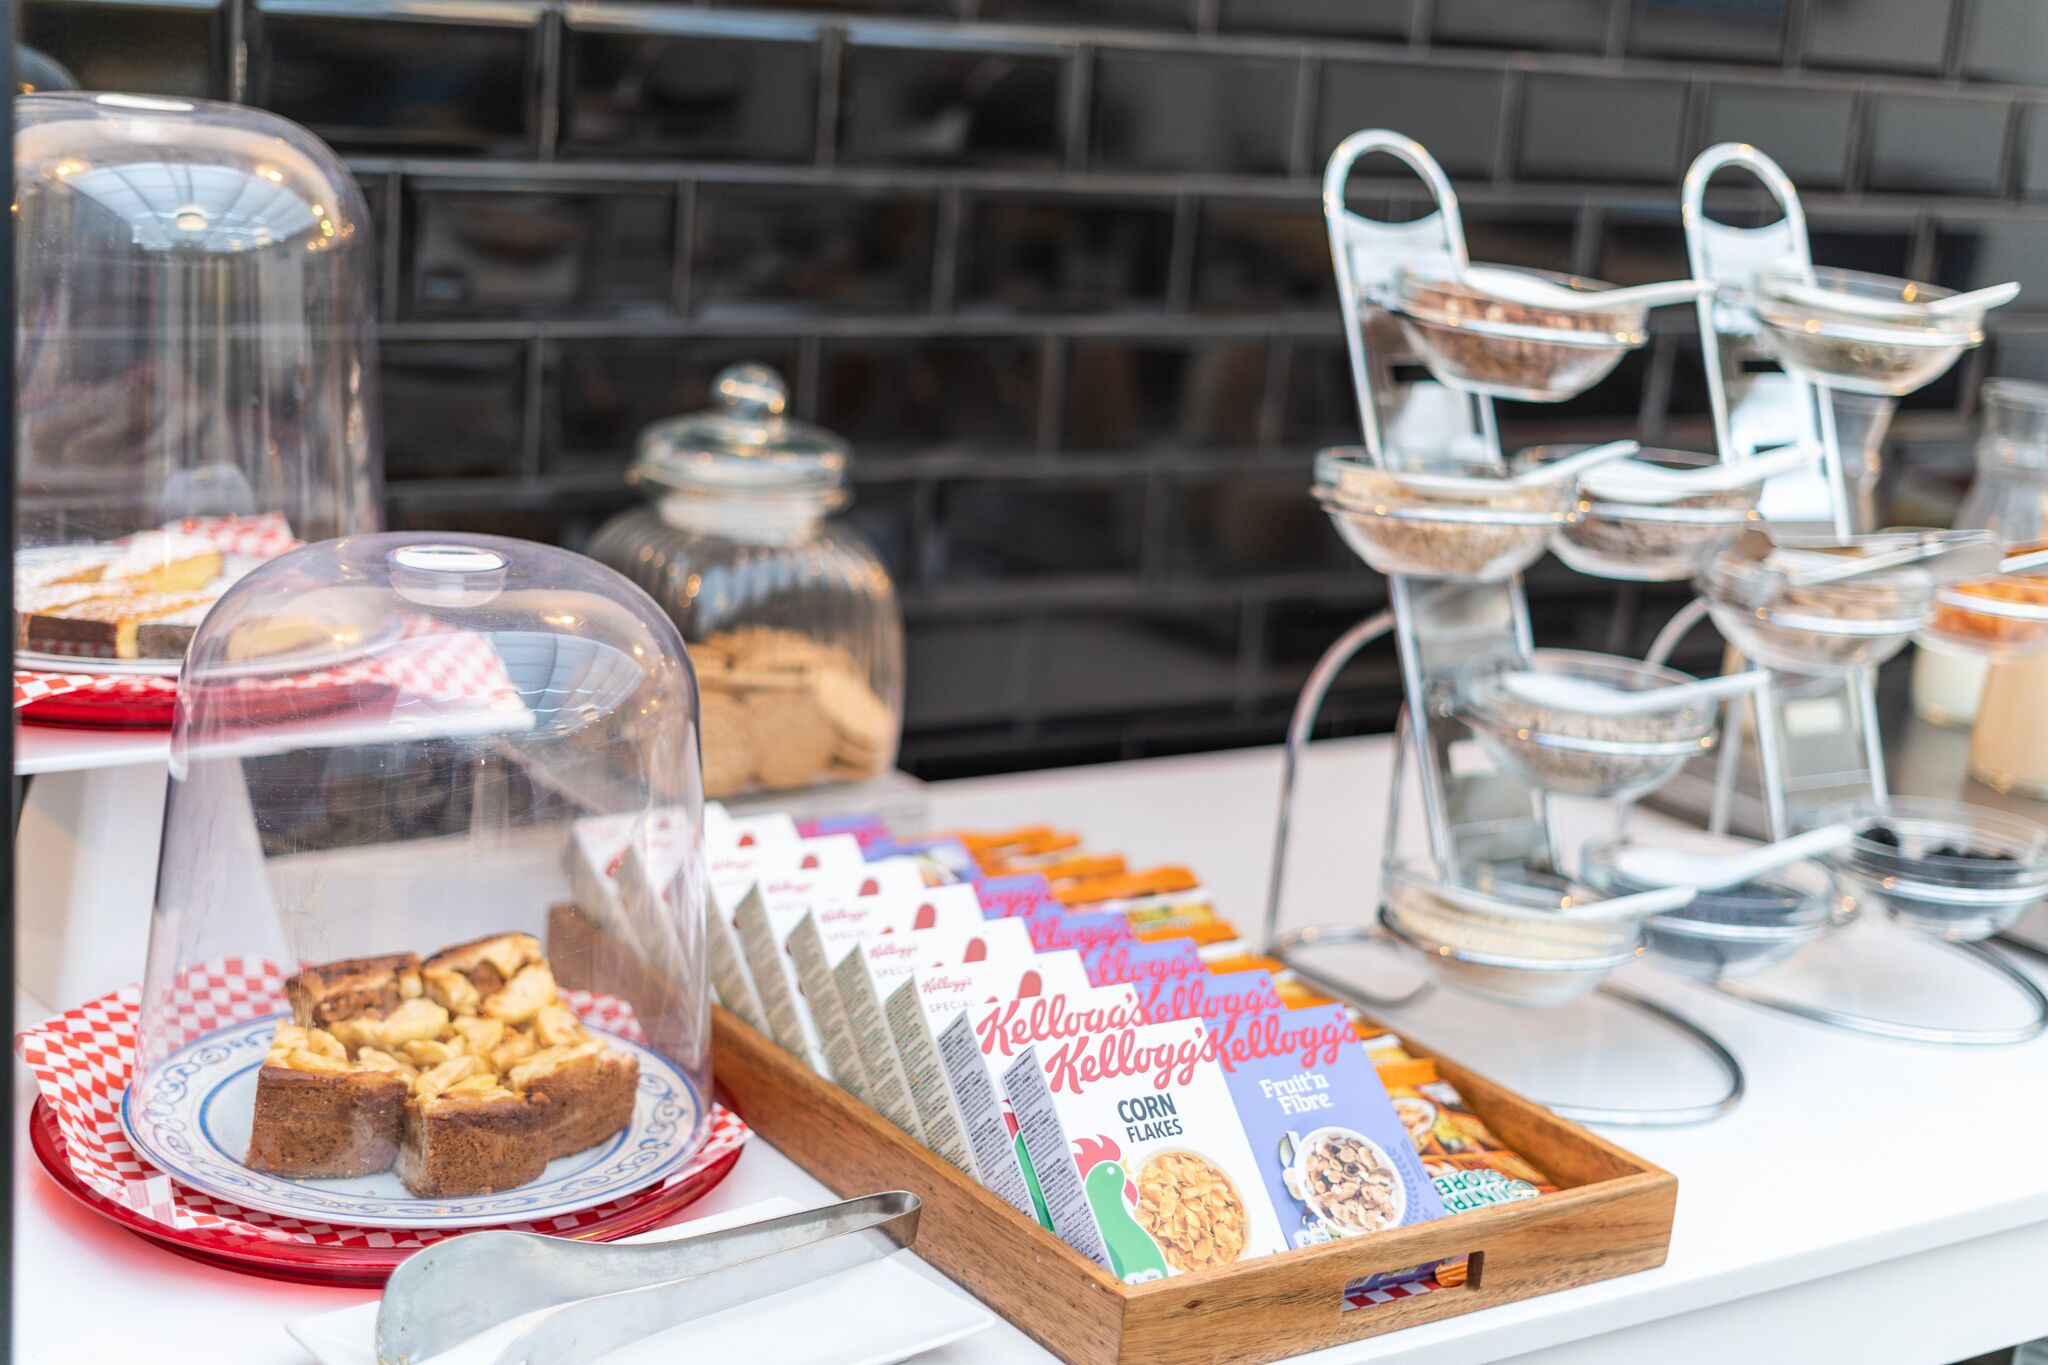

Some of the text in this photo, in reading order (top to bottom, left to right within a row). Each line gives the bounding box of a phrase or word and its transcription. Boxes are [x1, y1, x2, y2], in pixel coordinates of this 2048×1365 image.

[1208, 1010, 1359, 1073] Kellogg's
[1044, 1026, 1217, 1094] Kellogg's
[1117, 1092, 1177, 1123] CORN
[1278, 1093, 1335, 1115] Fibre
[1126, 1118, 1183, 1143] FLAKES
